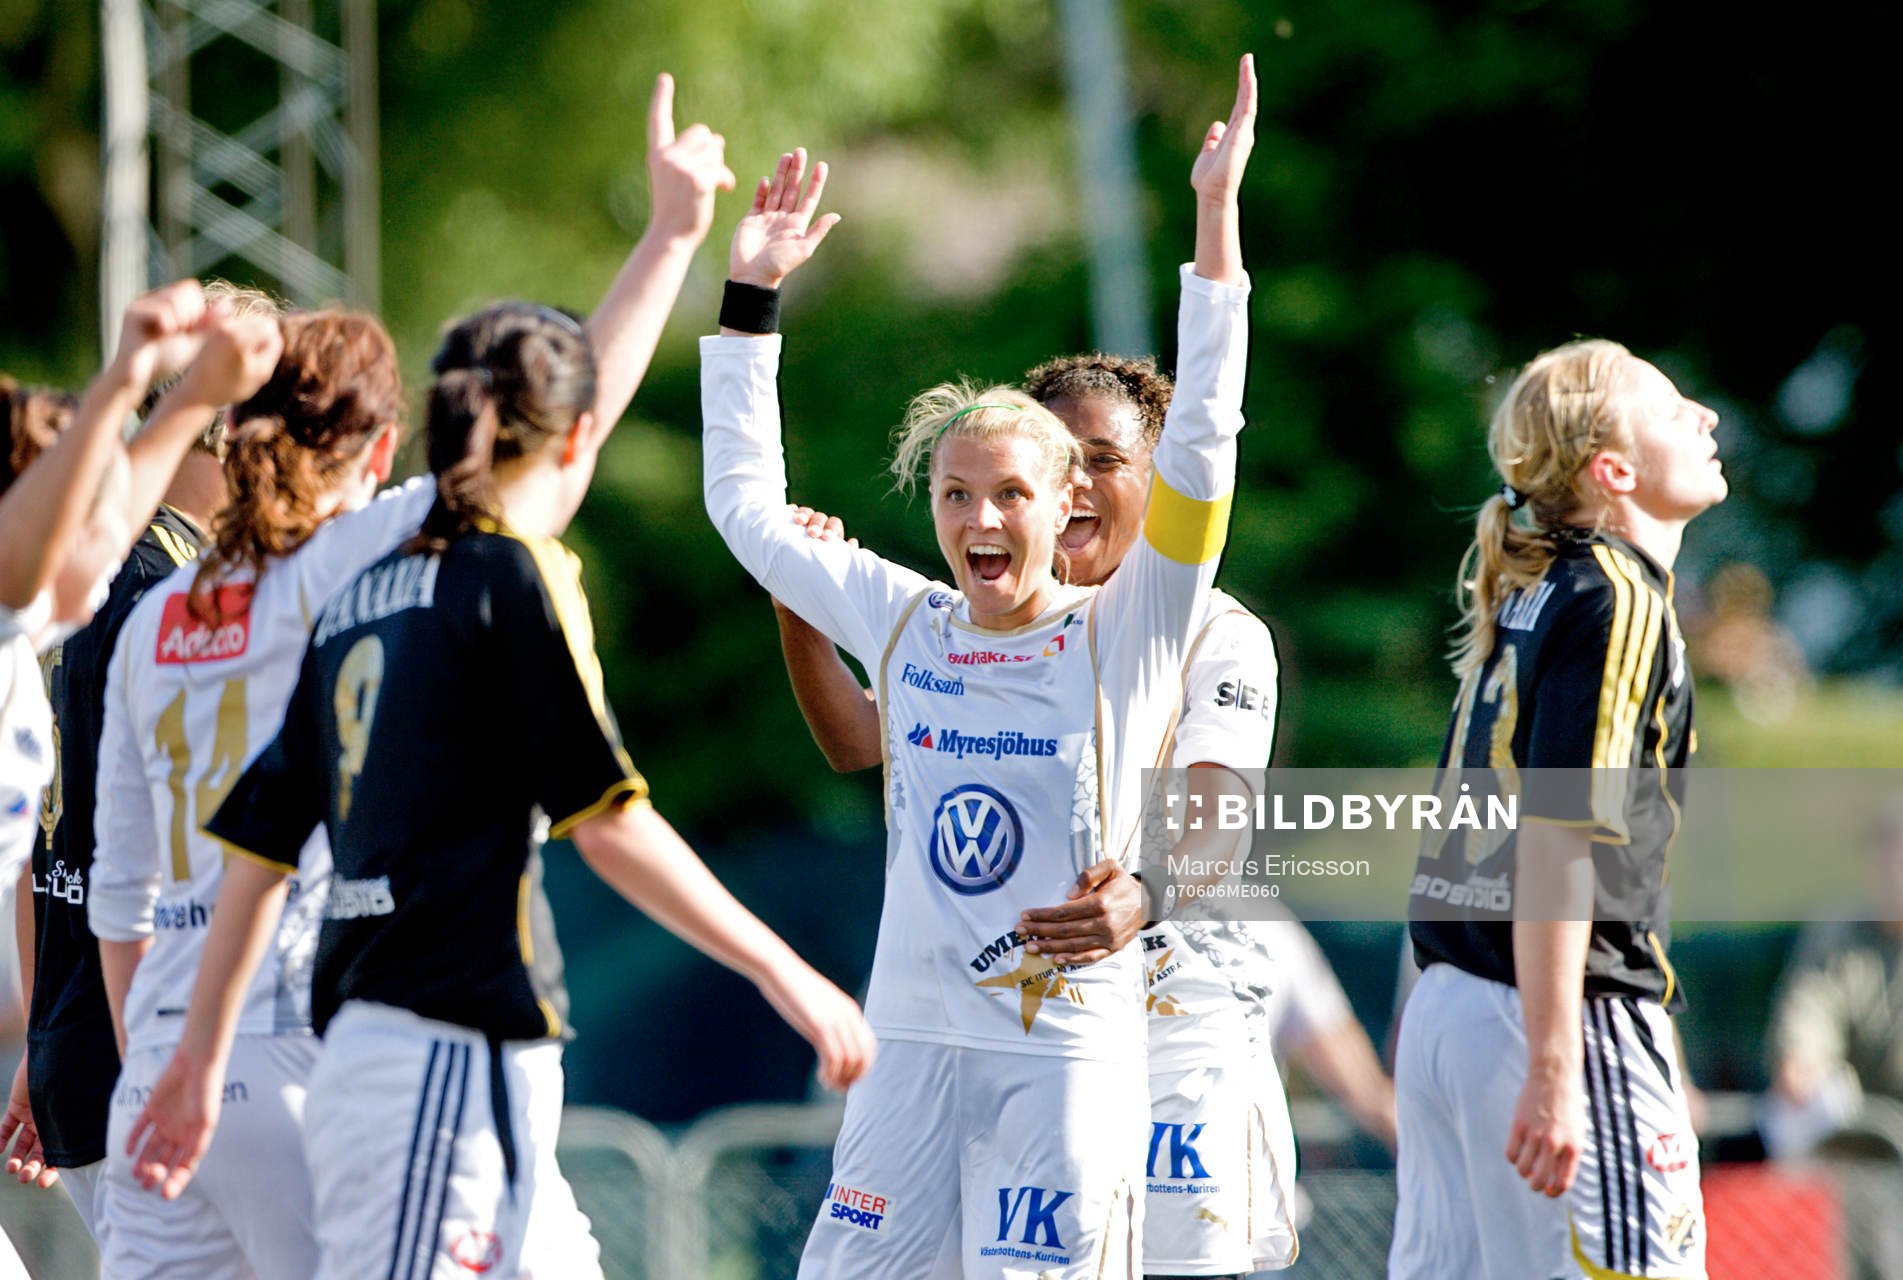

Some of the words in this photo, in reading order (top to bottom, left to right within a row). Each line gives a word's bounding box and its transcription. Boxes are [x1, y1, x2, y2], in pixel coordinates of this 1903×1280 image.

[901, 662, 965, 696] Folksam
[936, 729, 1058, 761] Myresjöhus
[970, 930, 1046, 973] UME
[830, 1202, 884, 1230] SPORT
[833, 1184, 887, 1215] INTER
[996, 1186, 1075, 1250] VK
